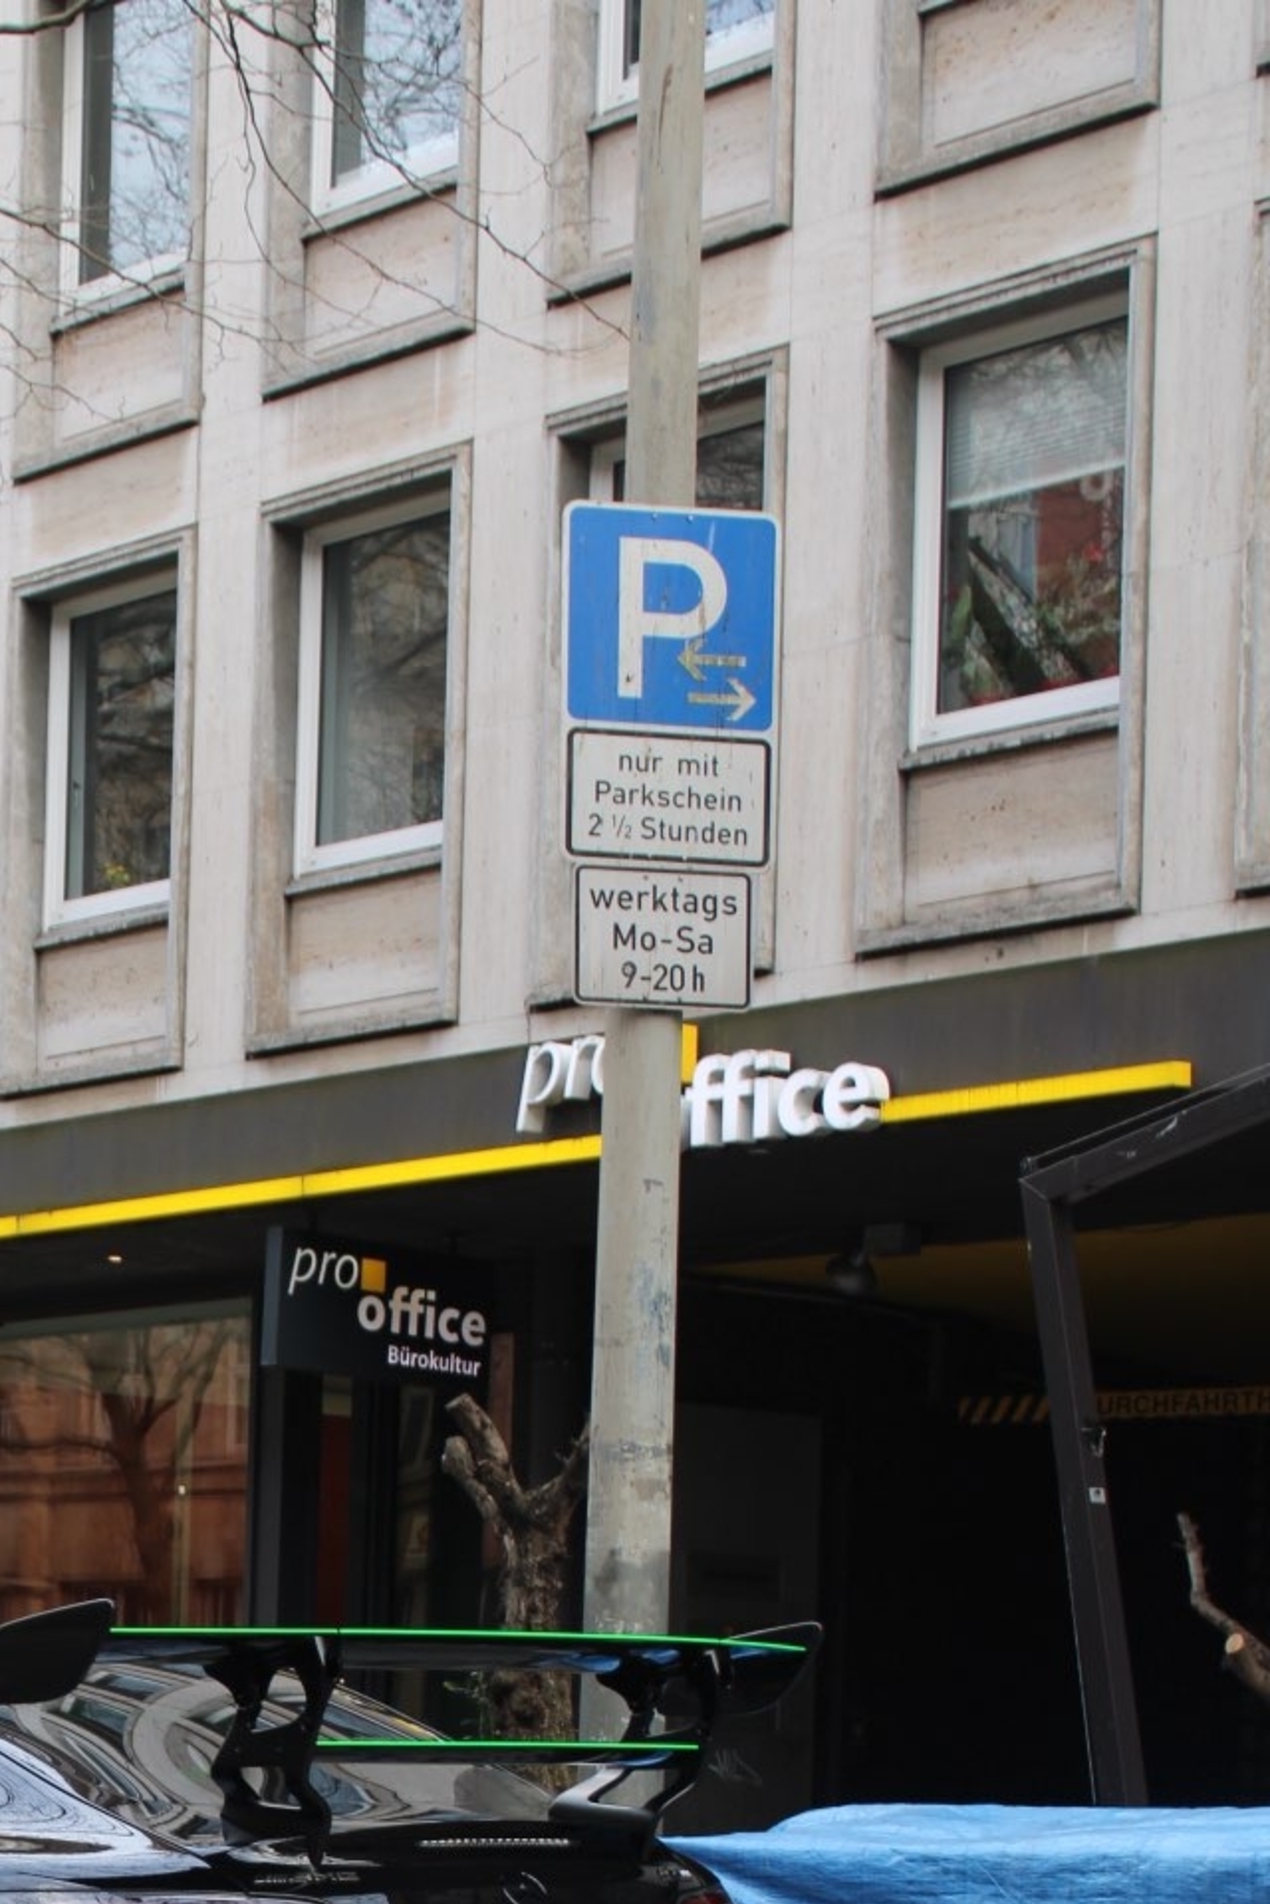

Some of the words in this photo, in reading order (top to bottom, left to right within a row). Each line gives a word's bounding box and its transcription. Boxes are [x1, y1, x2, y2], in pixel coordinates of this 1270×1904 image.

[617, 536, 728, 698] P
[618, 753, 663, 775] nur
[677, 753, 719, 778] mit
[594, 780, 742, 812] Parkschein
[587, 814, 603, 837] 2
[640, 817, 748, 847] Stunden
[588, 886, 738, 922] werktags
[612, 925, 714, 955] Mo-Sa
[681, 1047, 890, 1148] ffice
[287, 1245, 359, 1295] pro
[357, 1286, 488, 1348] office
[386, 1344, 482, 1379] Bürokultur
[1096, 1390, 1270, 1415] URCHFAHRTH
